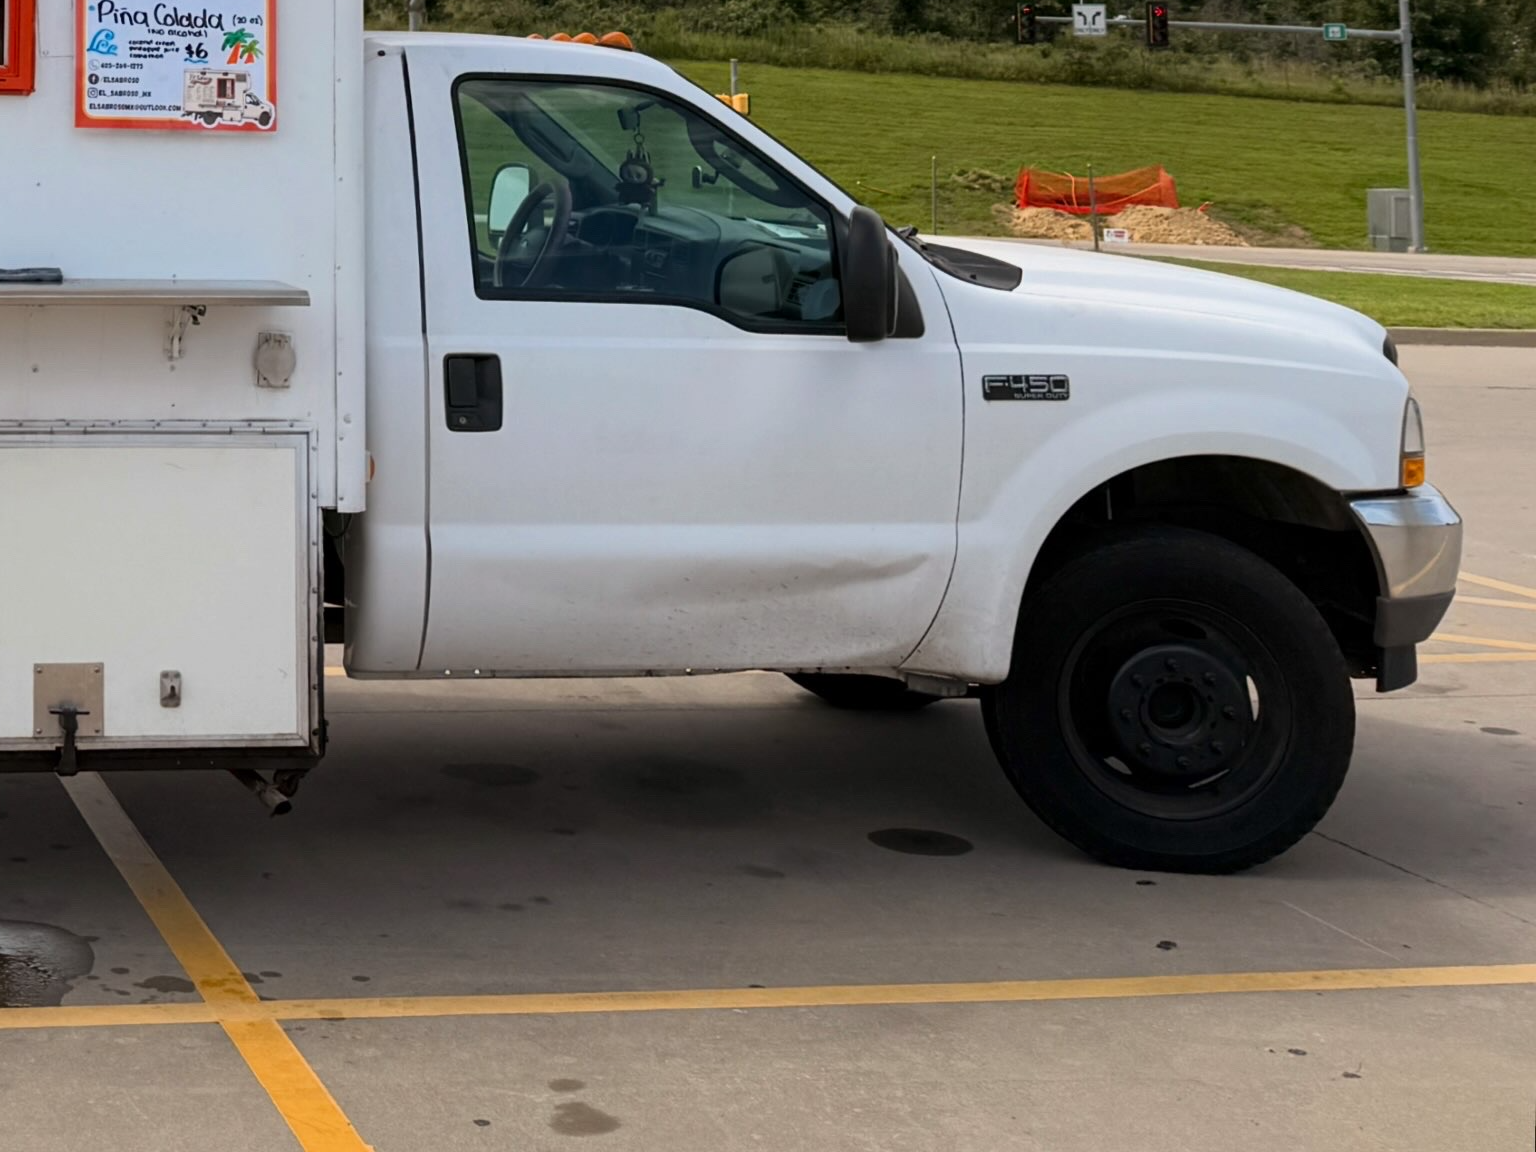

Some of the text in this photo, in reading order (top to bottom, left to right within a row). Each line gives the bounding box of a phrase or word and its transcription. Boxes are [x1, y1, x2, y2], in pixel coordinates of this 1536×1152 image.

[97, 0, 149, 27] Piña
[154, 3, 224, 31] Colada
[184, 42, 209, 59] $6
